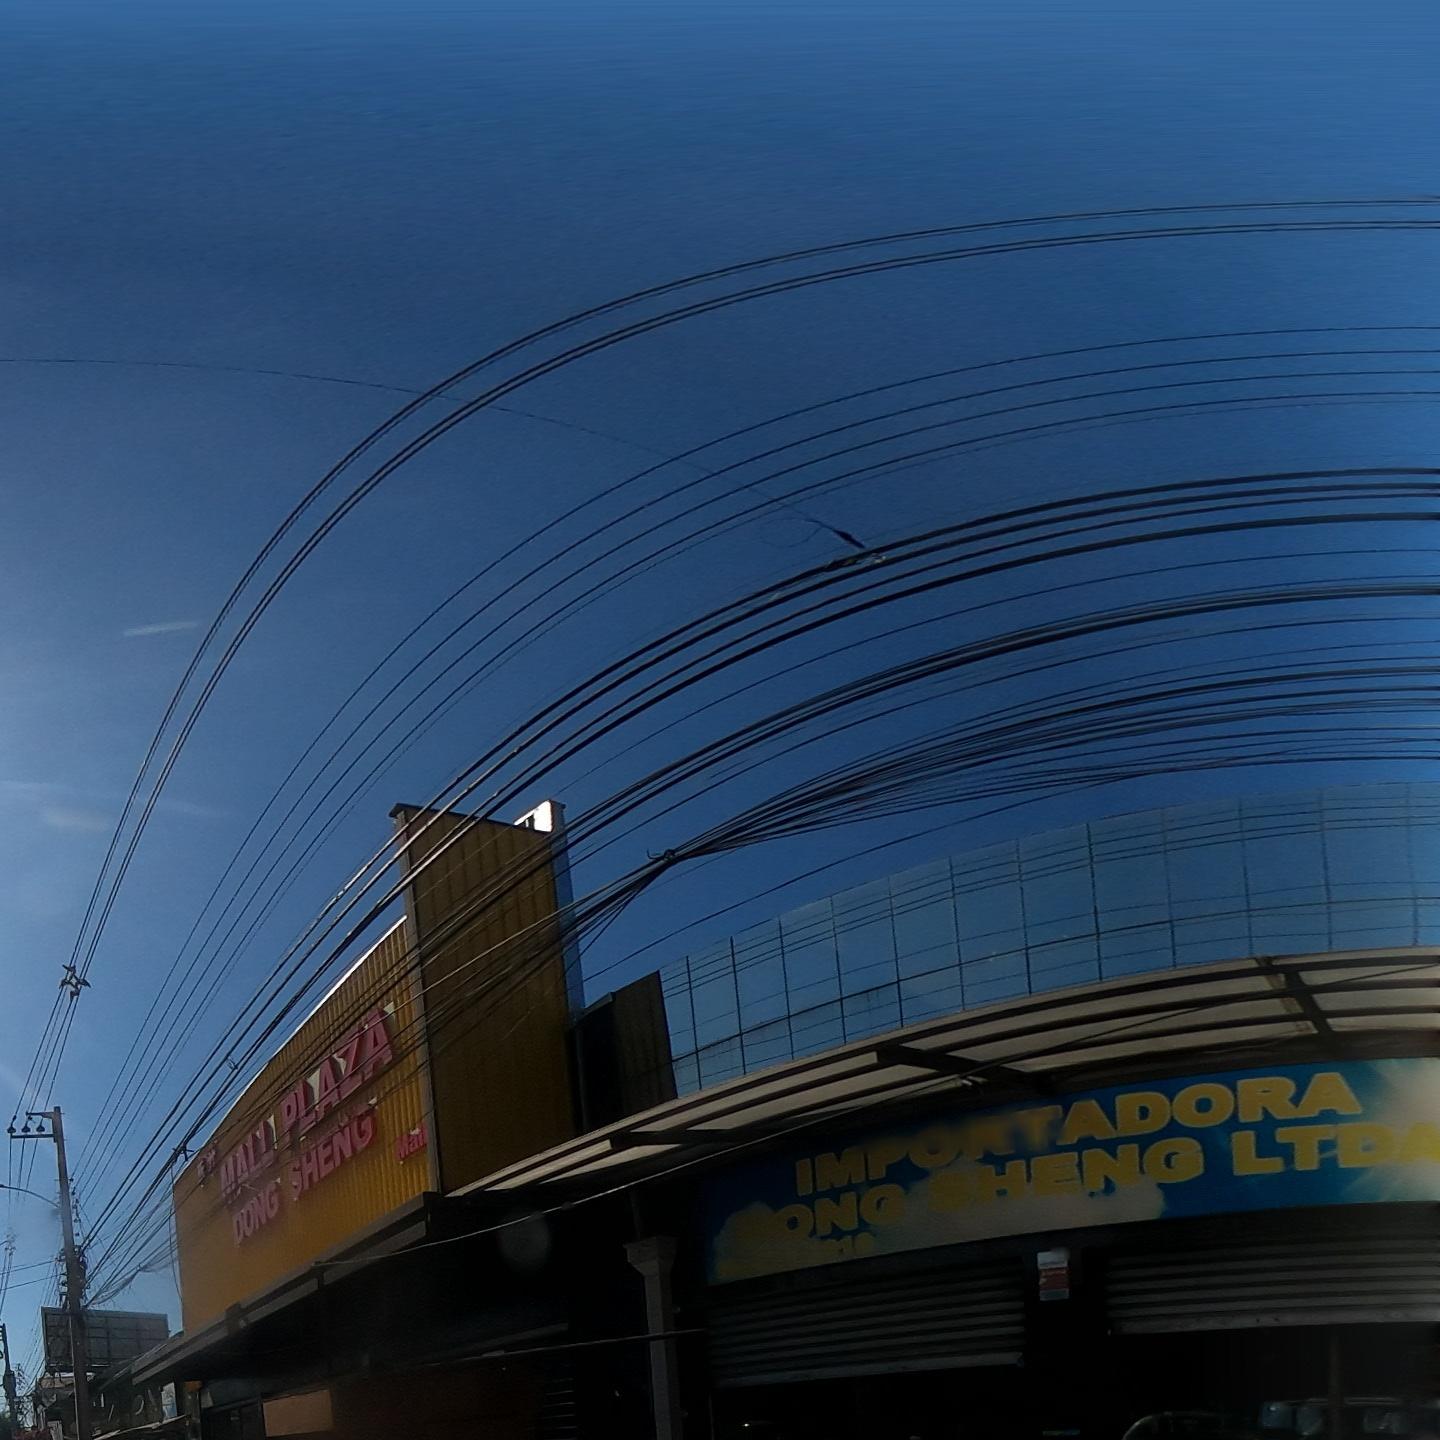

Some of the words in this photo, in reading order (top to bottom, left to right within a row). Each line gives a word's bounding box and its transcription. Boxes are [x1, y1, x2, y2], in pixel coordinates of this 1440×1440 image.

[221, 1119, 276, 1198] MALL
[280, 1007, 393, 1145] PLAZA
[795, 1073, 1361, 1196] IMPORTADORA
[233, 1181, 280, 1243] DONG
[288, 1108, 377, 1199] SHENG
[736, 1184, 906, 1242] ONG
[928, 1138, 1204, 1213] SHENG
